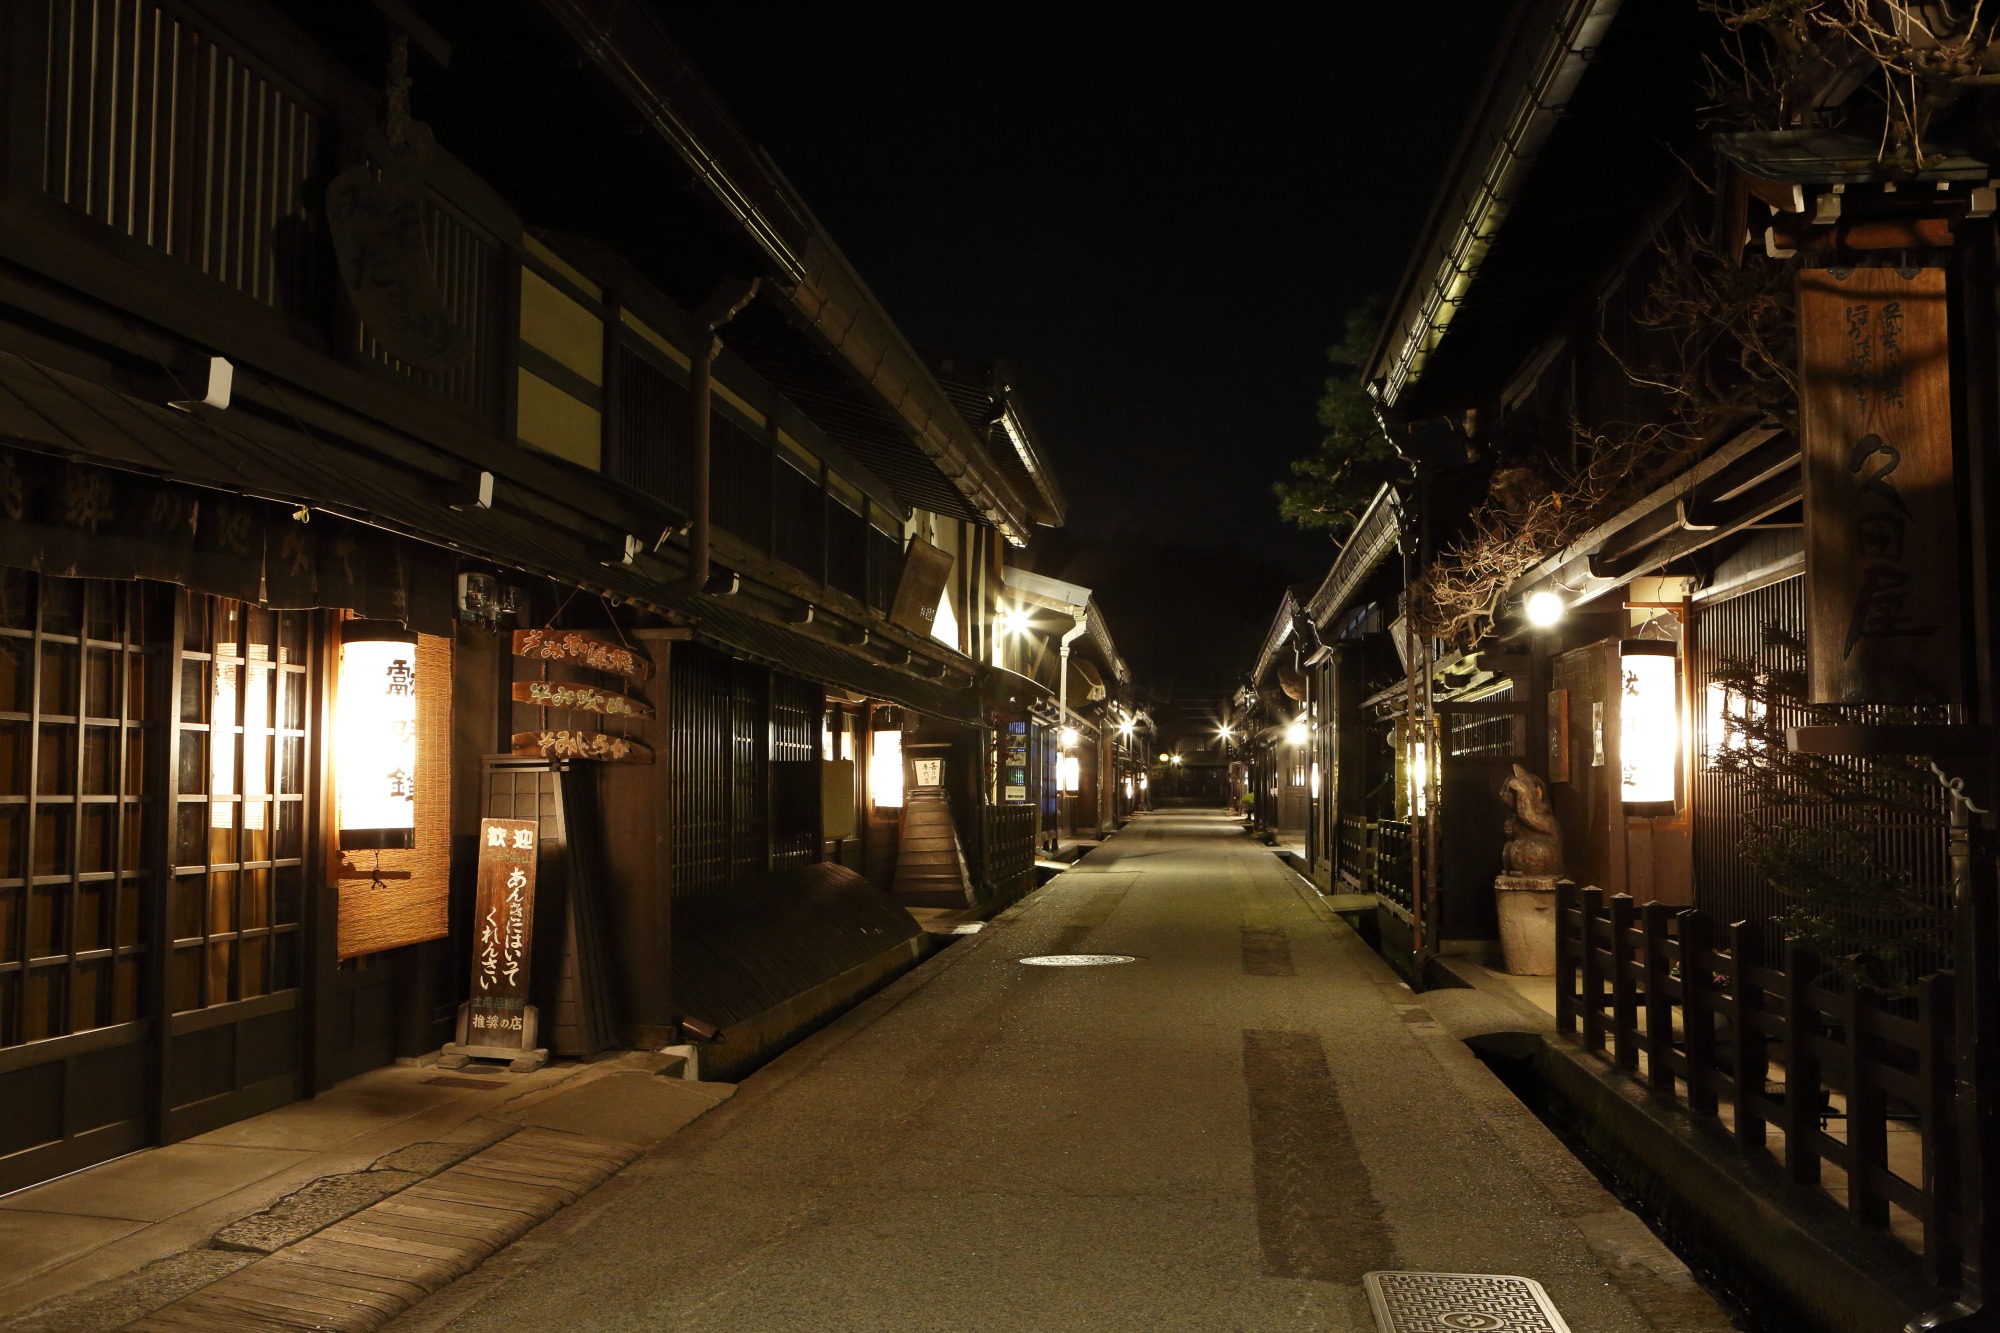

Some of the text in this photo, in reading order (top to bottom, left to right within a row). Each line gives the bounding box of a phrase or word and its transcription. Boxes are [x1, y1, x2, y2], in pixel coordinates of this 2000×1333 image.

[1843, 433, 1943, 661] 久田屋
[486, 825, 534, 850] 歓迎
[479, 906, 501, 990] くれんさい
[502, 867, 527, 987] あんきにはいって
[472, 995, 525, 1010] 土産品組合
[472, 1013, 522, 1031] 推奨の店
